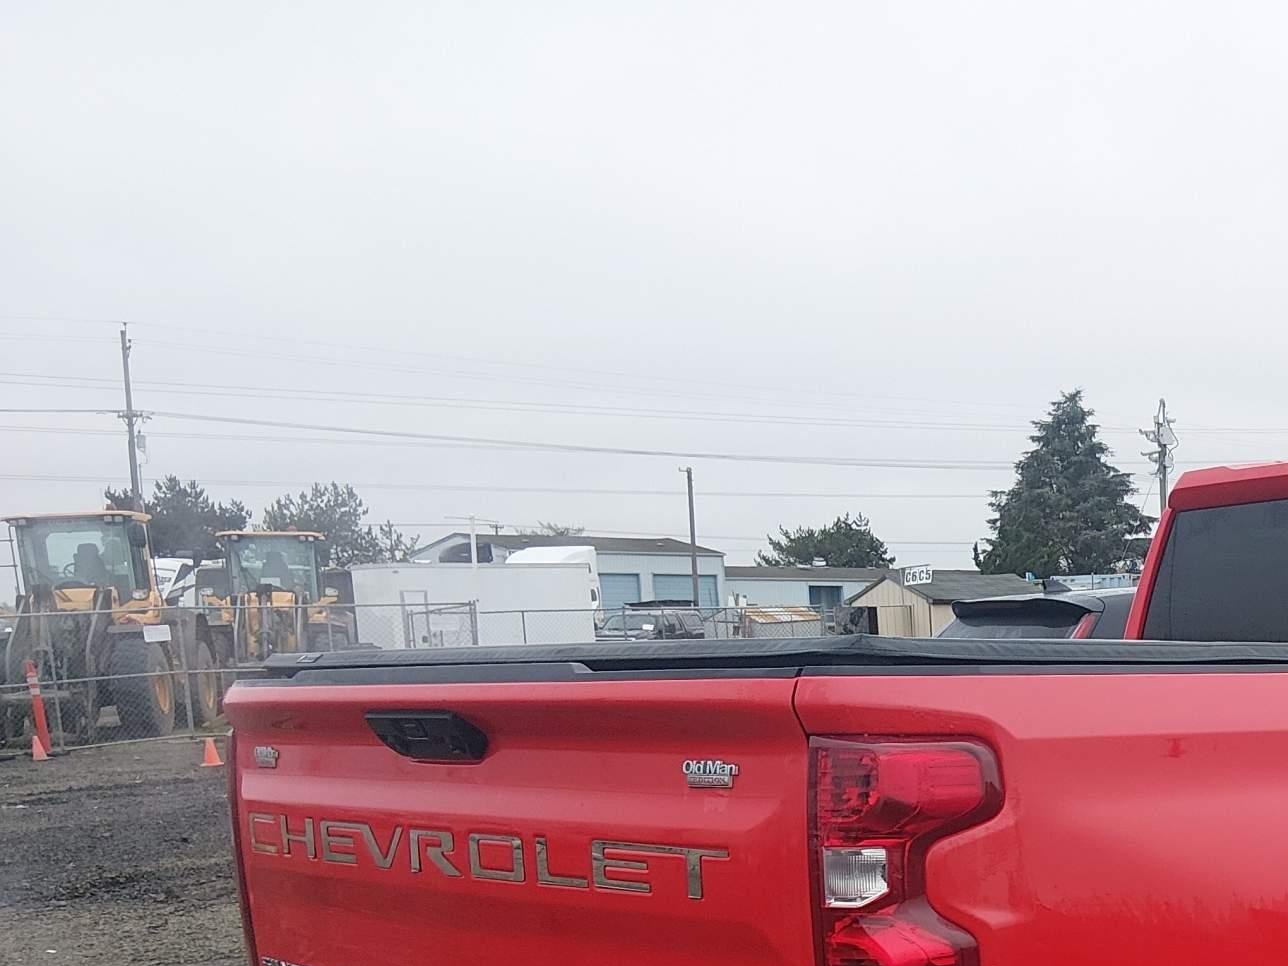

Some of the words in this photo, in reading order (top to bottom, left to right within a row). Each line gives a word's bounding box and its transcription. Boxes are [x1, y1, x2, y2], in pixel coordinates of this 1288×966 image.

[682, 760, 704, 774] Old
[706, 760, 739, 776] Man
[248, 811, 730, 900] CHEVROLET
